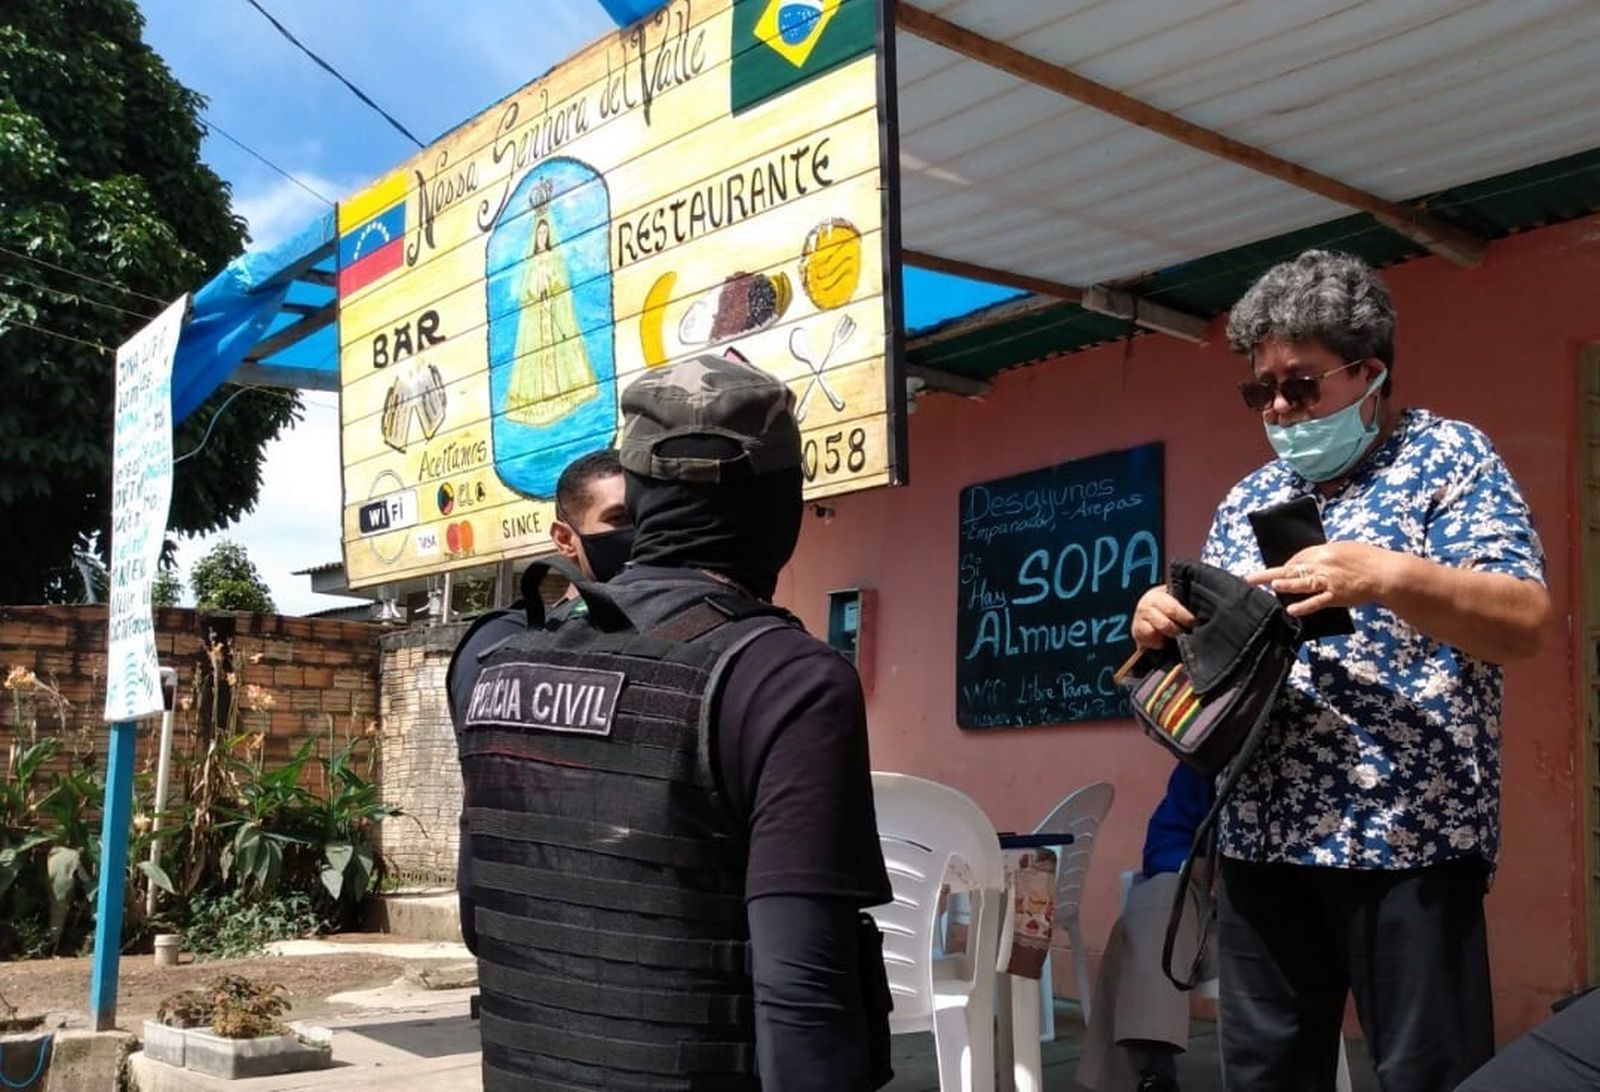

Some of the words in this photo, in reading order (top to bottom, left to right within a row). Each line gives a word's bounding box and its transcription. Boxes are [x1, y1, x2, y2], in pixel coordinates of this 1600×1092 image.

[407, 151, 477, 267] Nossa
[477, 88, 589, 233] Senhora
[600, 43, 637, 118] del
[631, 0, 706, 127] Valle
[618, 138, 834, 262] RESTAURANTE
[373, 310, 446, 369] BAR
[419, 440, 487, 481] Aceitamos
[963, 479, 1115, 524] Desayunos
[502, 513, 542, 540] SINCE
[1012, 530, 1159, 604] SOPA
[532, 682, 607, 726] CIVIL
[1018, 674, 1055, 704] Libre
[1057, 673, 1093, 700] Para
